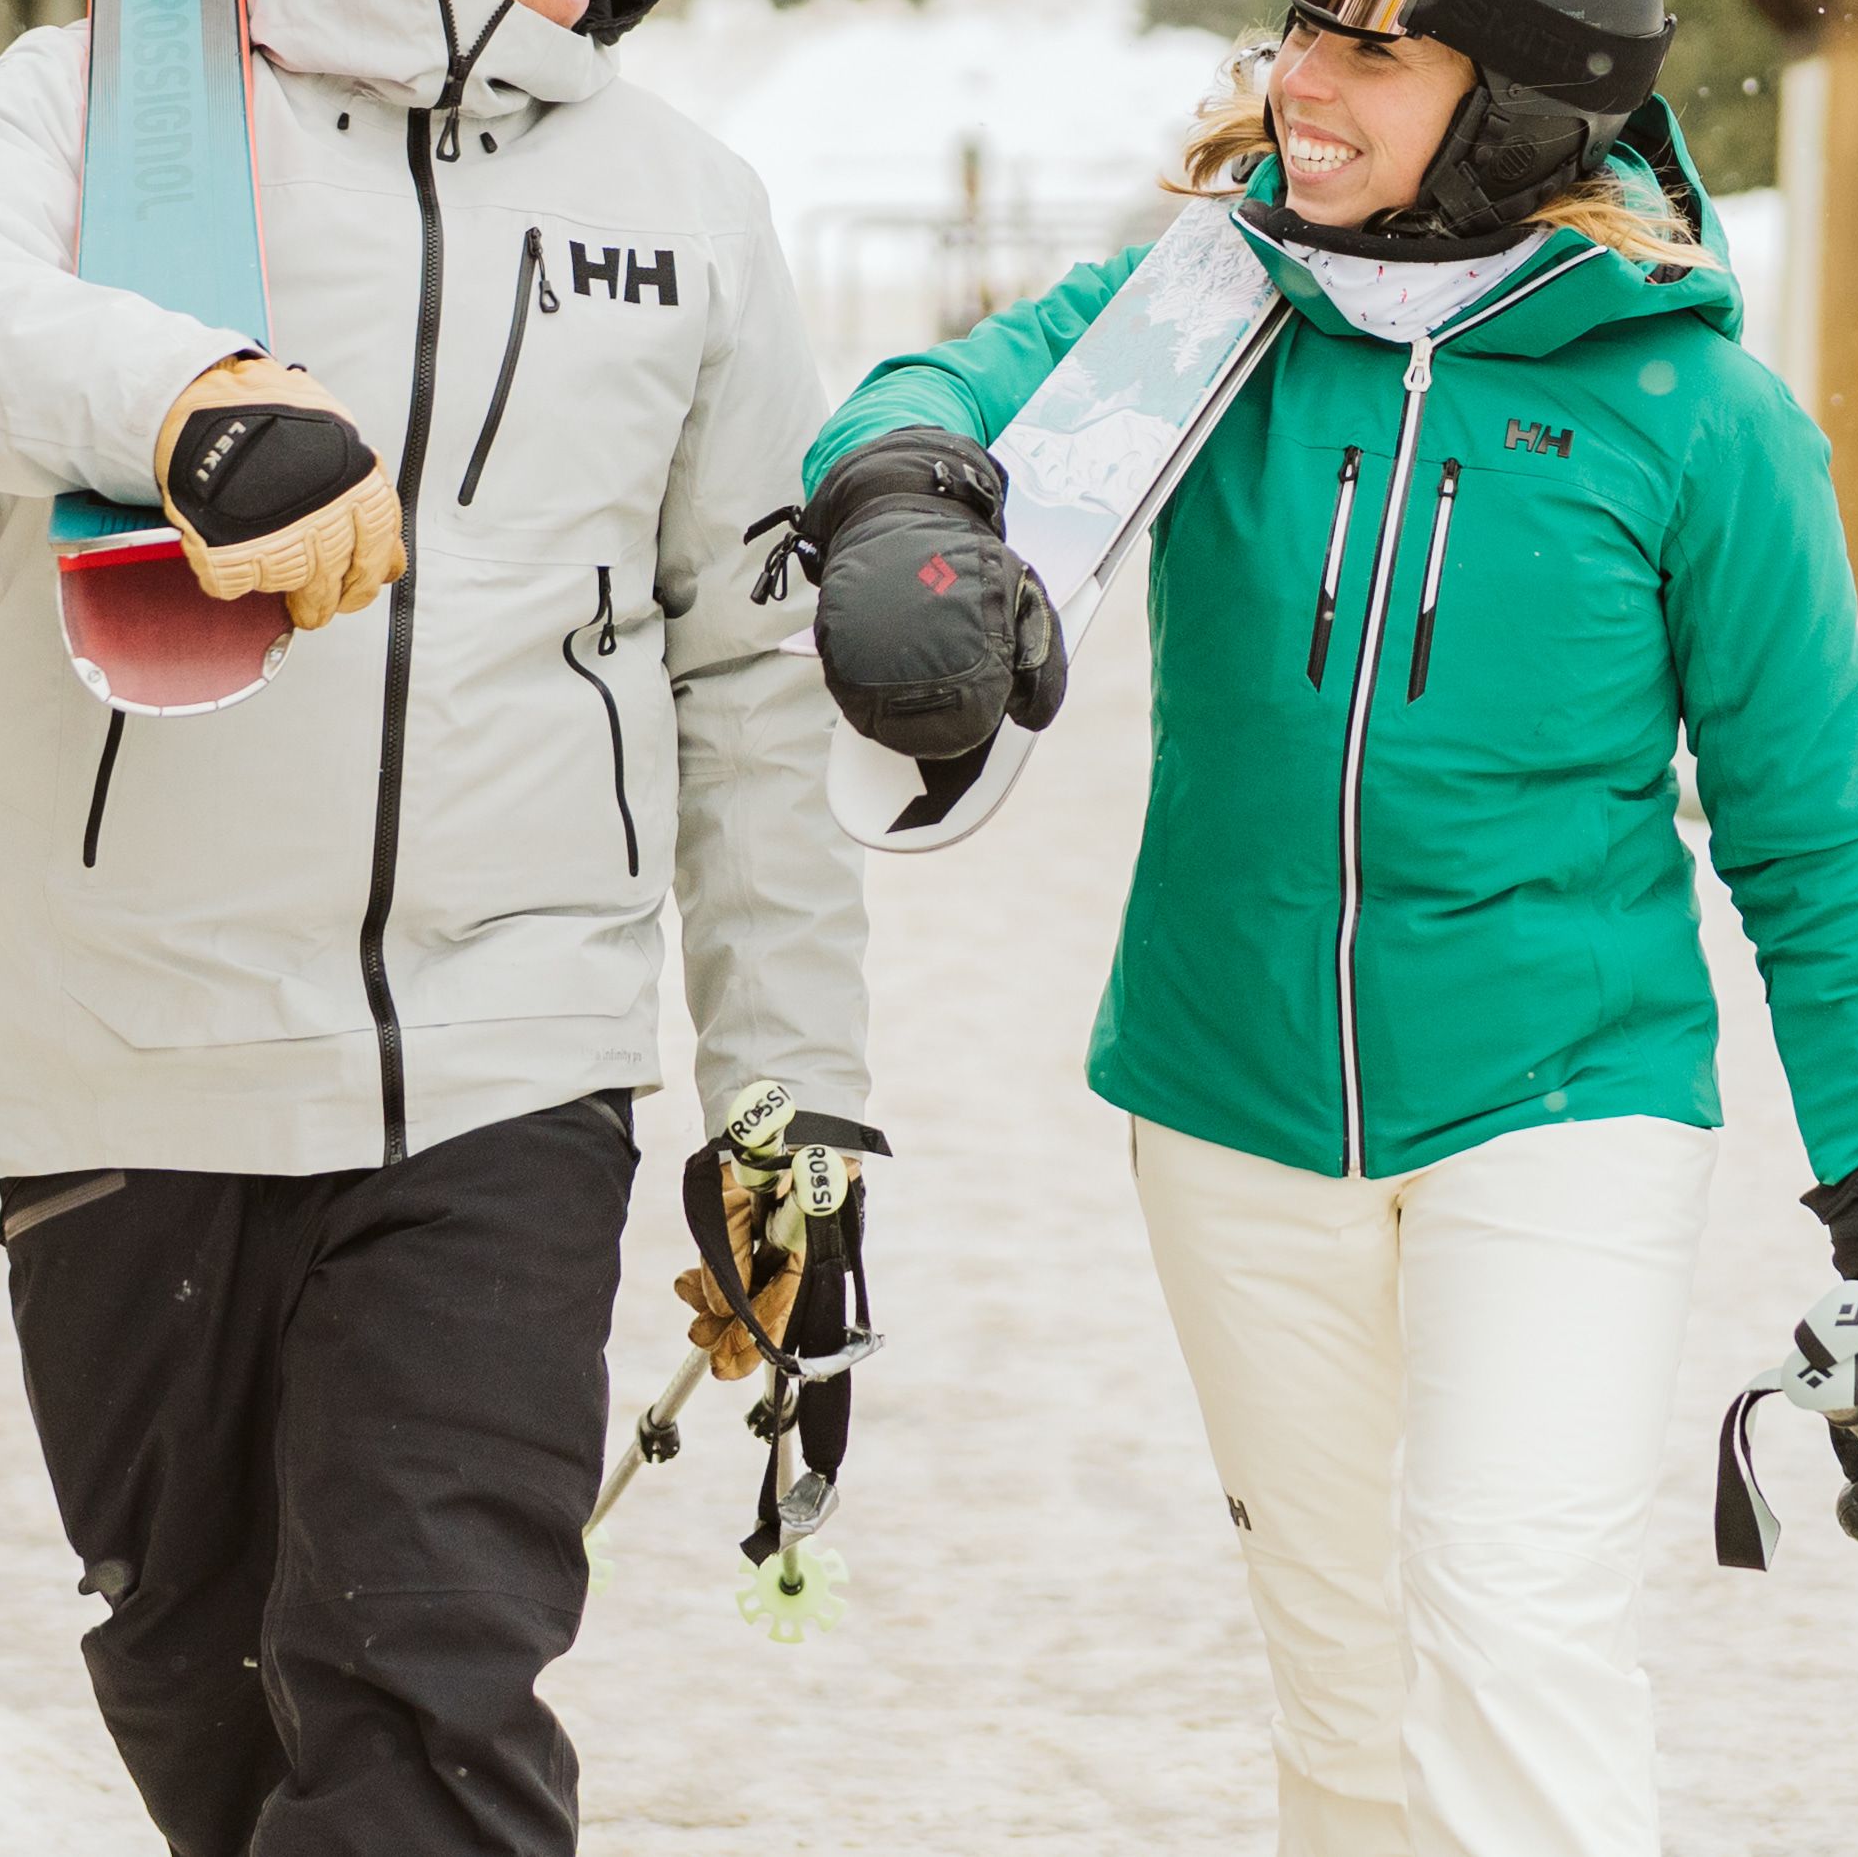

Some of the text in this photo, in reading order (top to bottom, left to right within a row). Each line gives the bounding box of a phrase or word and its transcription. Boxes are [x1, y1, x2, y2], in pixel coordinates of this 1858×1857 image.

[569, 239, 680, 307] HH
[196, 421, 246, 482] LEKI
[1504, 417, 1574, 460] HH
[731, 1085, 791, 1141] ROSSI
[807, 1146, 832, 1212] ROSSI
[1222, 1486, 1252, 1532] H
